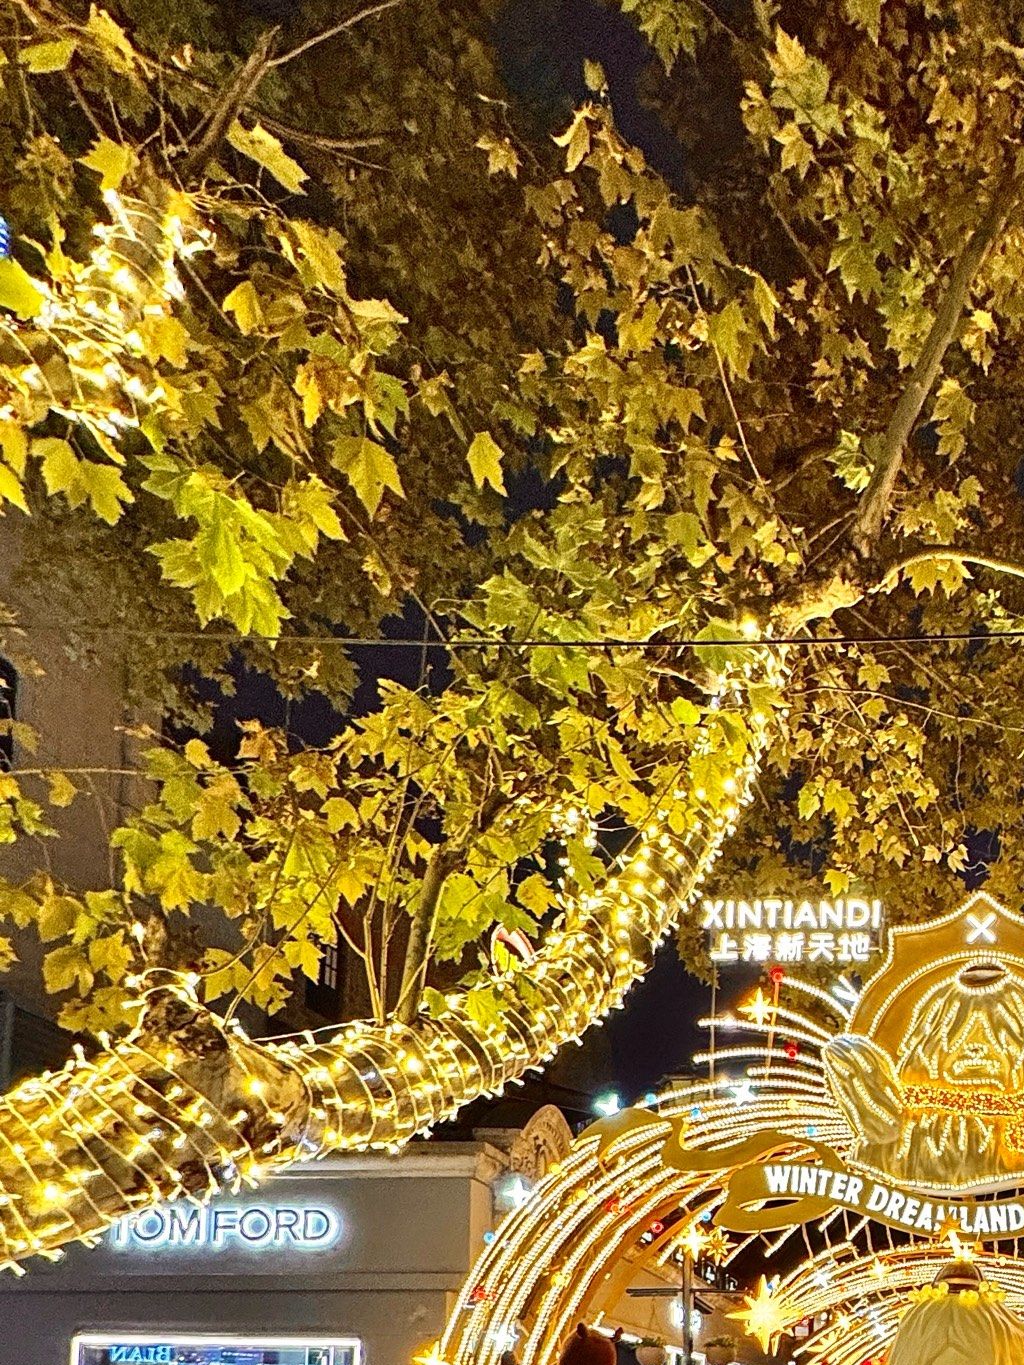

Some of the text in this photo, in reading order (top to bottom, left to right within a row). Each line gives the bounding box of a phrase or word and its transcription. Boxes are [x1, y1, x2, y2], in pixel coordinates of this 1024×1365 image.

[702, 899, 882, 930] XINTIANDI
[709, 932, 871, 962] 上海新天地
[764, 1165, 863, 1206] WINTER
[212, 1208, 330, 1242] FORD
